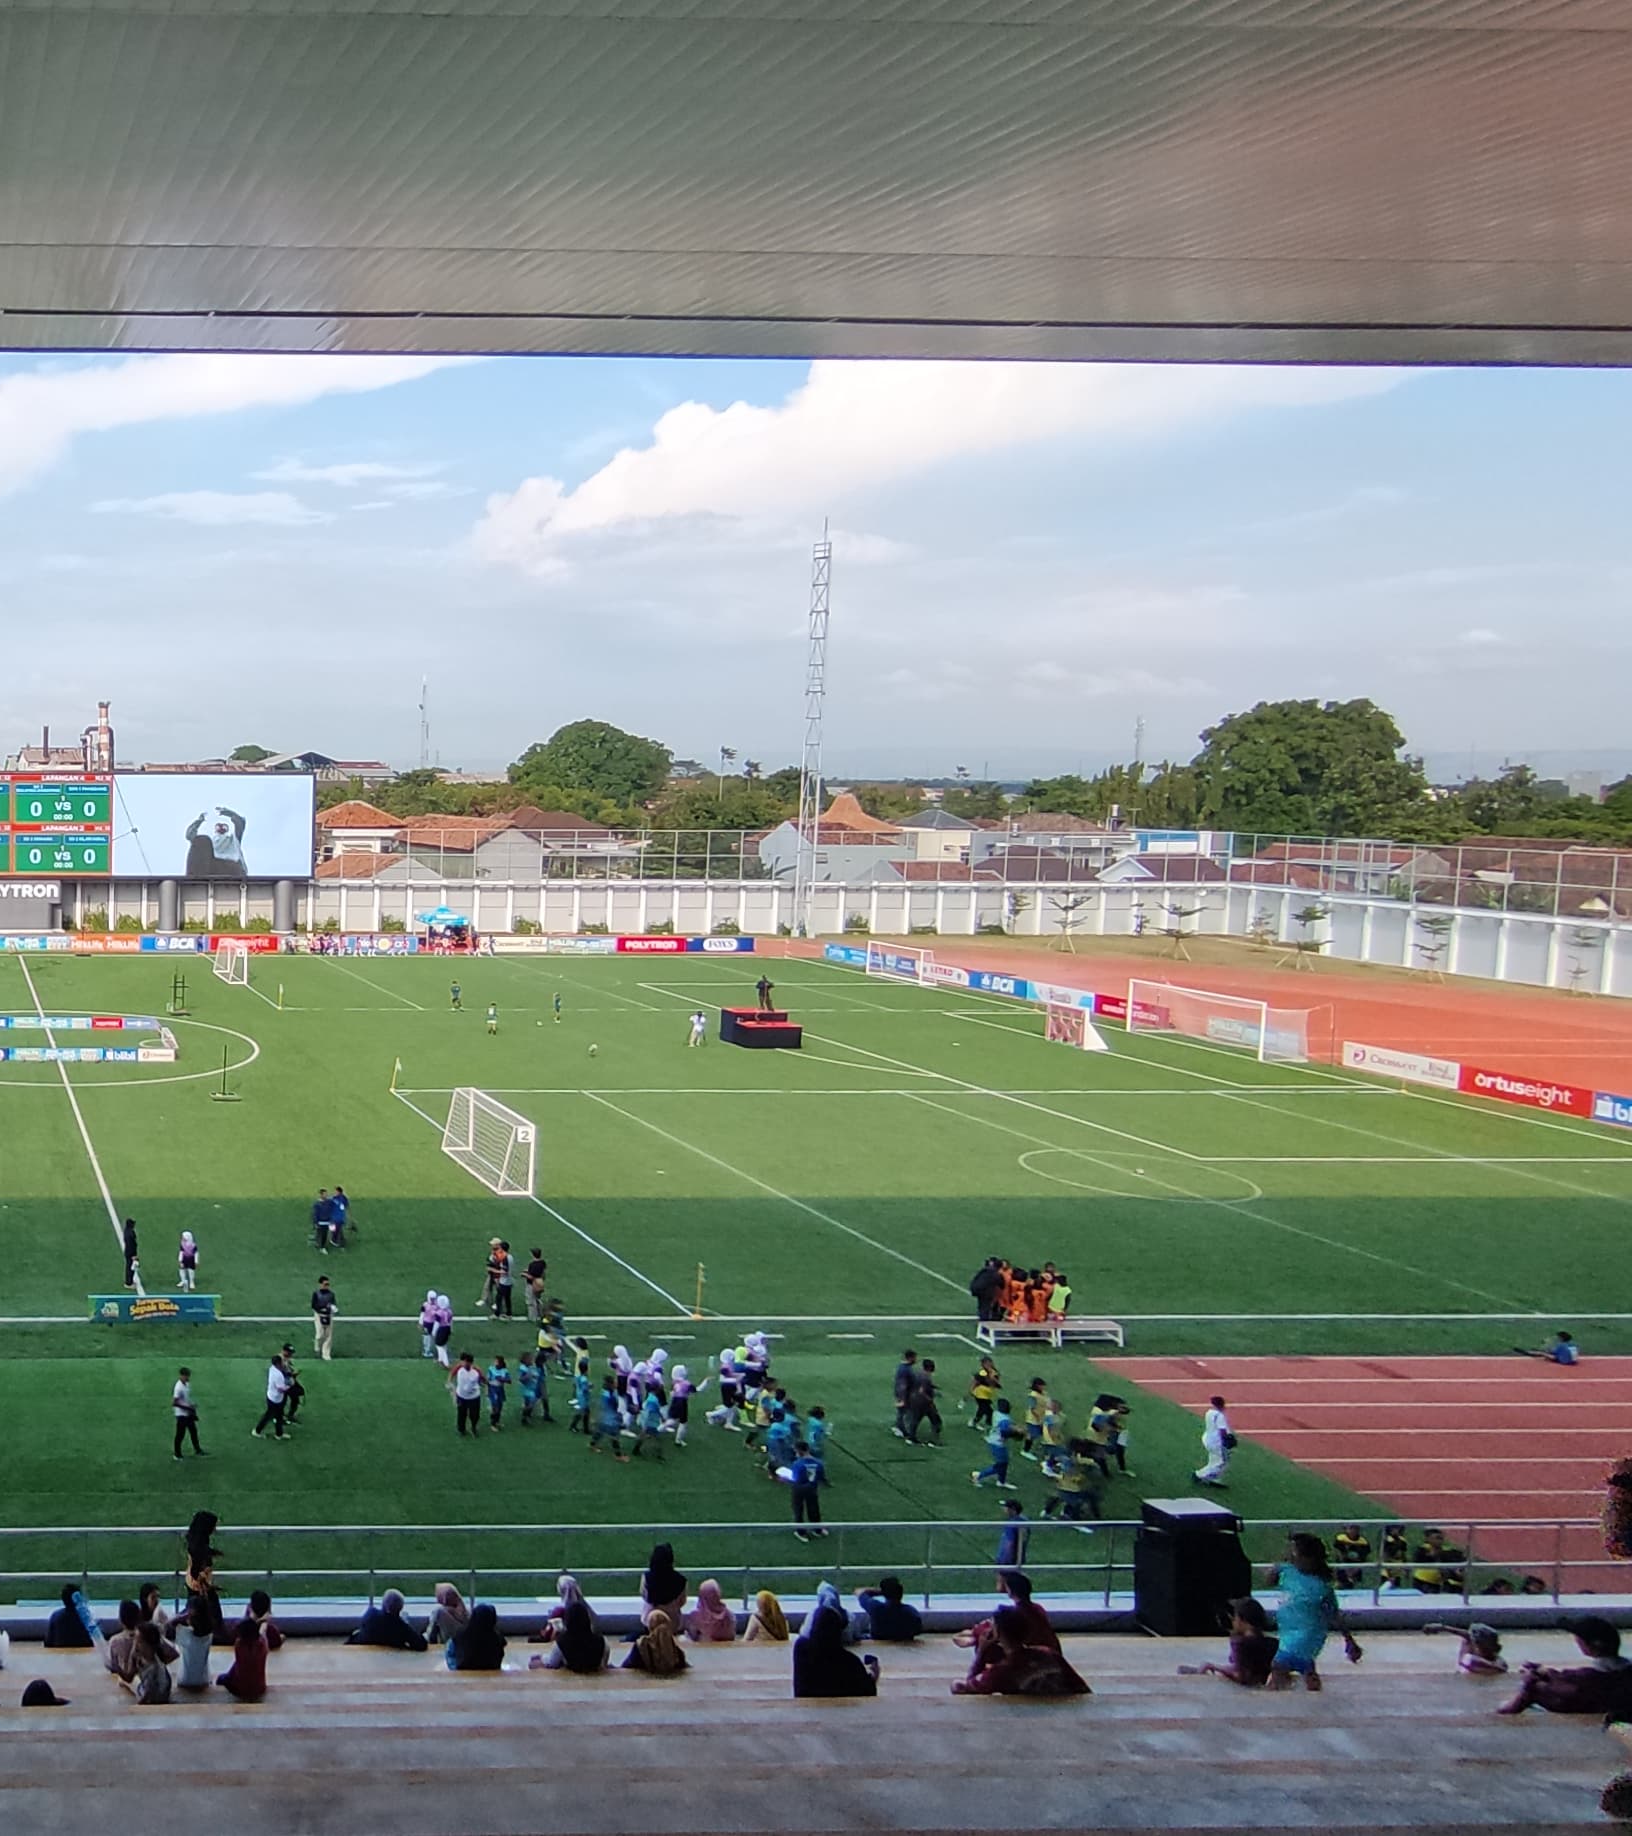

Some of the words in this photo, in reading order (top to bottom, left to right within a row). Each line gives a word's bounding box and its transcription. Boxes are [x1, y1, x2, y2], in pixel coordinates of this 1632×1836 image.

[30, 801, 42, 817] 0
[54, 802, 72, 811] VS
[83, 801, 96, 817] 0
[29, 848, 42, 864] 0
[54, 851, 71, 861] VS
[83, 848, 96, 864] 0
[169, 937, 196, 949] BCA
[625, 940, 678, 950] POLYTRON
[992, 976, 1015, 994] BCA
[1474, 1072, 1572, 1106] ortuseight
[520, 1131, 529, 1140] 2
